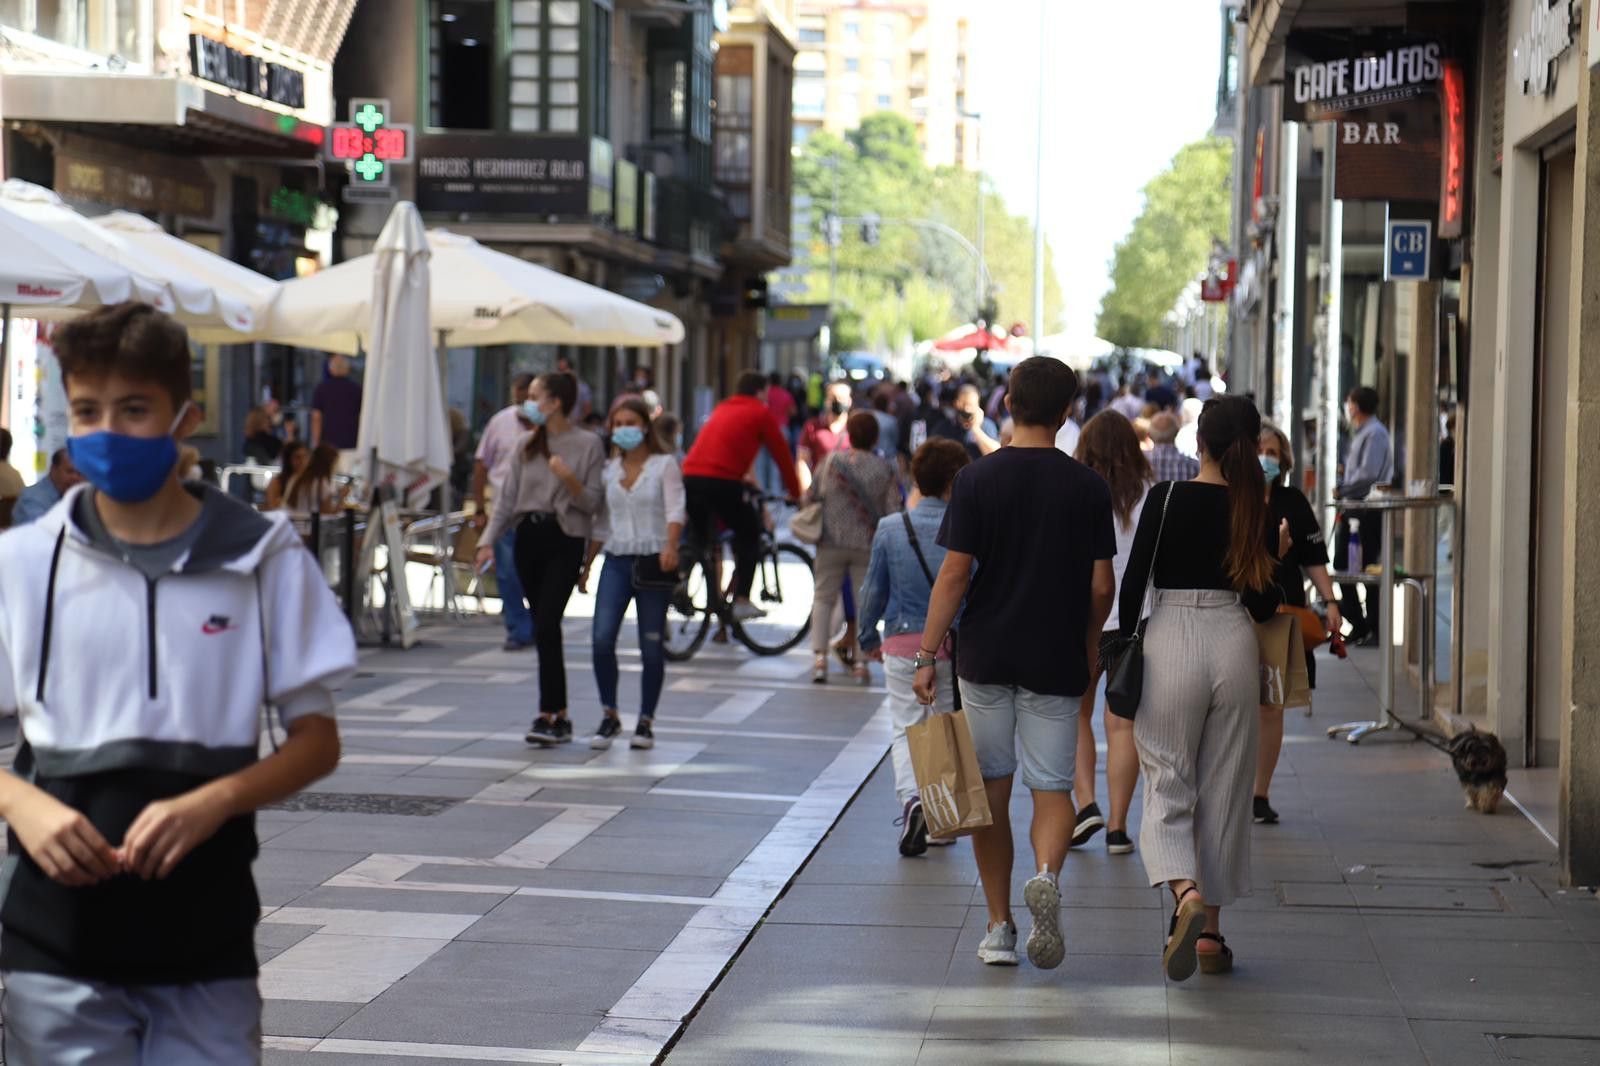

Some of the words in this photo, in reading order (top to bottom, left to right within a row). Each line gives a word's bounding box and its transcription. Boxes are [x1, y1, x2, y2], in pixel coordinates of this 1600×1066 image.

[1294, 58, 1349, 103] CAFE
[333, 128, 405, 159] 03:30
[1343, 122, 1401, 144] BAR
[1394, 231, 1423, 253] CB
